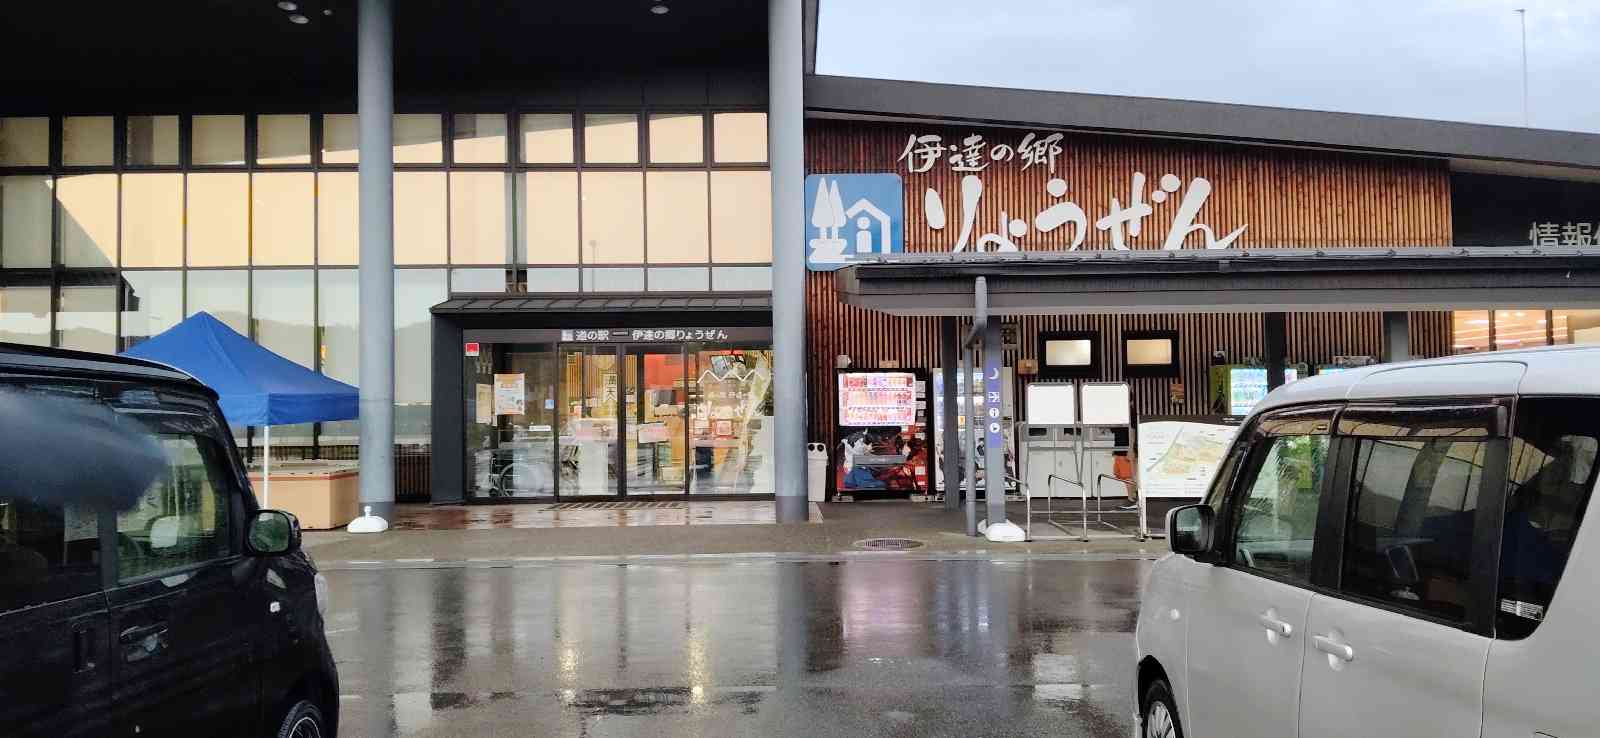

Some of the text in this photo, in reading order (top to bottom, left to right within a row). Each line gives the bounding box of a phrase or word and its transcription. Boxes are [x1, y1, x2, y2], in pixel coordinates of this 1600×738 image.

[898, 132, 1063, 173] 伊達の郷
[924, 172, 1249, 250] りょうぜん
[576, 329, 728, 341] 道の駅 伊達の郷りょうぜん
